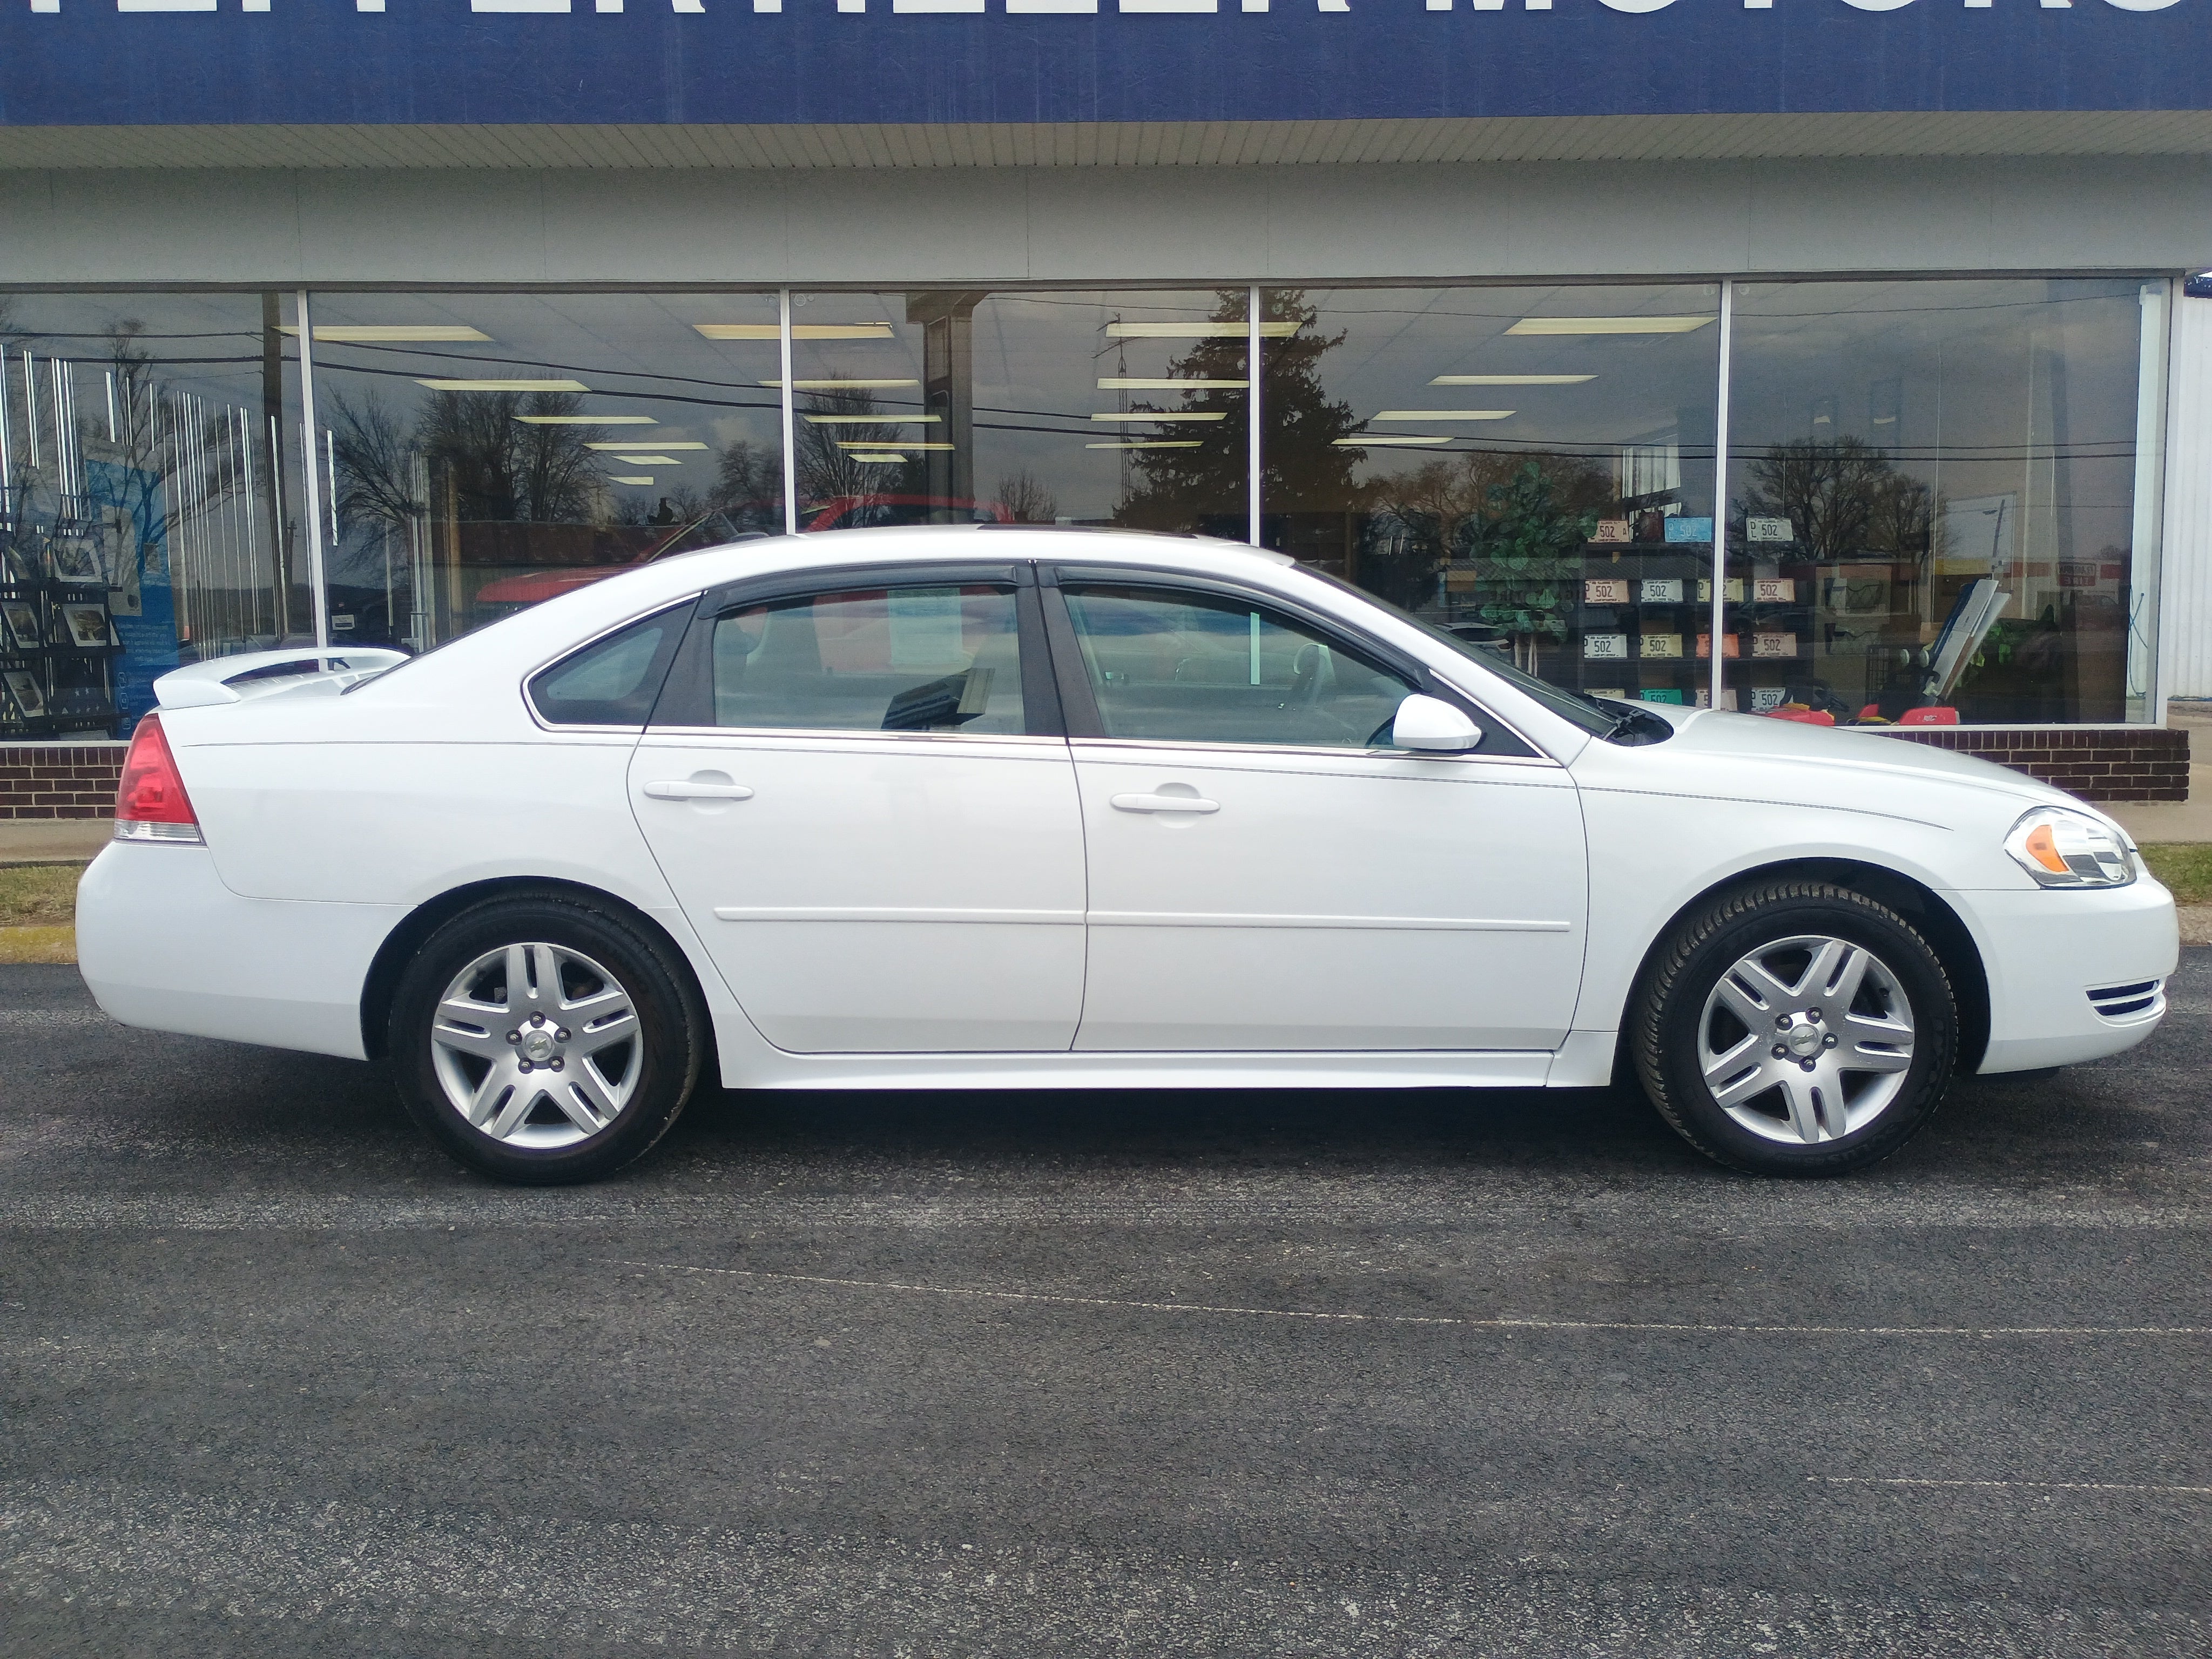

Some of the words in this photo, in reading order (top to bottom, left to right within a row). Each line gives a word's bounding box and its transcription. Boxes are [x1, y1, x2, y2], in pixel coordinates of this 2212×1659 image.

[1600, 525, 1615, 538] 502
[1680, 525, 1697, 537] 502
[1762, 524, 1778, 536] 502
[1596, 585, 1613, 598] 502
[1650, 585, 1667, 597] 502
[1760, 584, 1778, 597] 502
[1594, 640, 1611, 653] 502
[1649, 639, 1667, 652] 502
[1764, 638, 1781, 651] 502
[1761, 693, 1778, 706] 502
